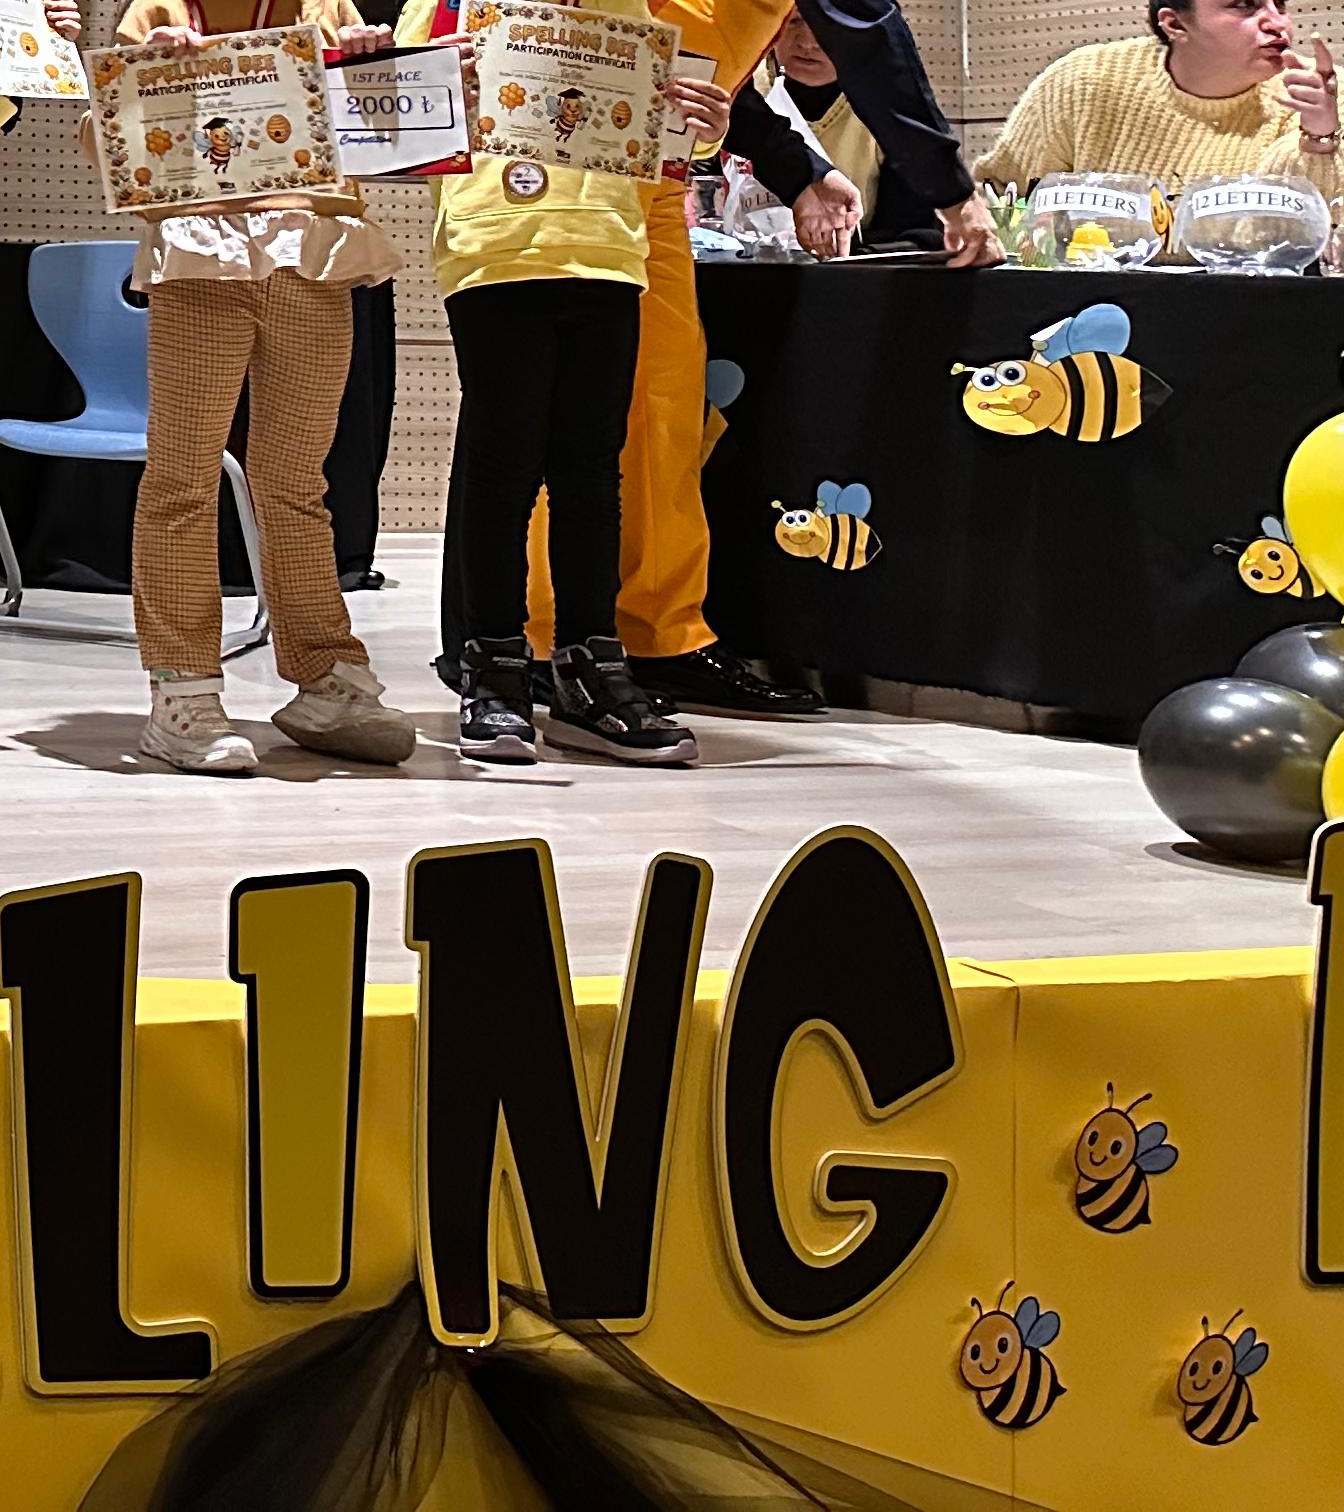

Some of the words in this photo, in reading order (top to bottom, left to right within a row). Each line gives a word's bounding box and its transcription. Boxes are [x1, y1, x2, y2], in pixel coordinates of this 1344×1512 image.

[508, 23, 601, 53] SPELLING
[606, 35, 638, 60] BEE
[506, 42, 584, 61] PARTICIPATION
[583, 53, 636, 71] CERTIFICATE
[137, 57, 233, 88] SPELLING
[237, 54, 277, 75] BEE
[352, 72, 375, 83] 1ST
[377, 71, 422, 83] PLACE
[138, 81, 215, 97] PARTICIPATION
[217, 72, 279, 90] CERTIFICATE
[346, 95, 412, 114] 2000
[1053, 192, 1138, 215] LETTERS
[1194, 195, 1209, 211] 12
[1215, 190, 1305, 212] LETTERS
